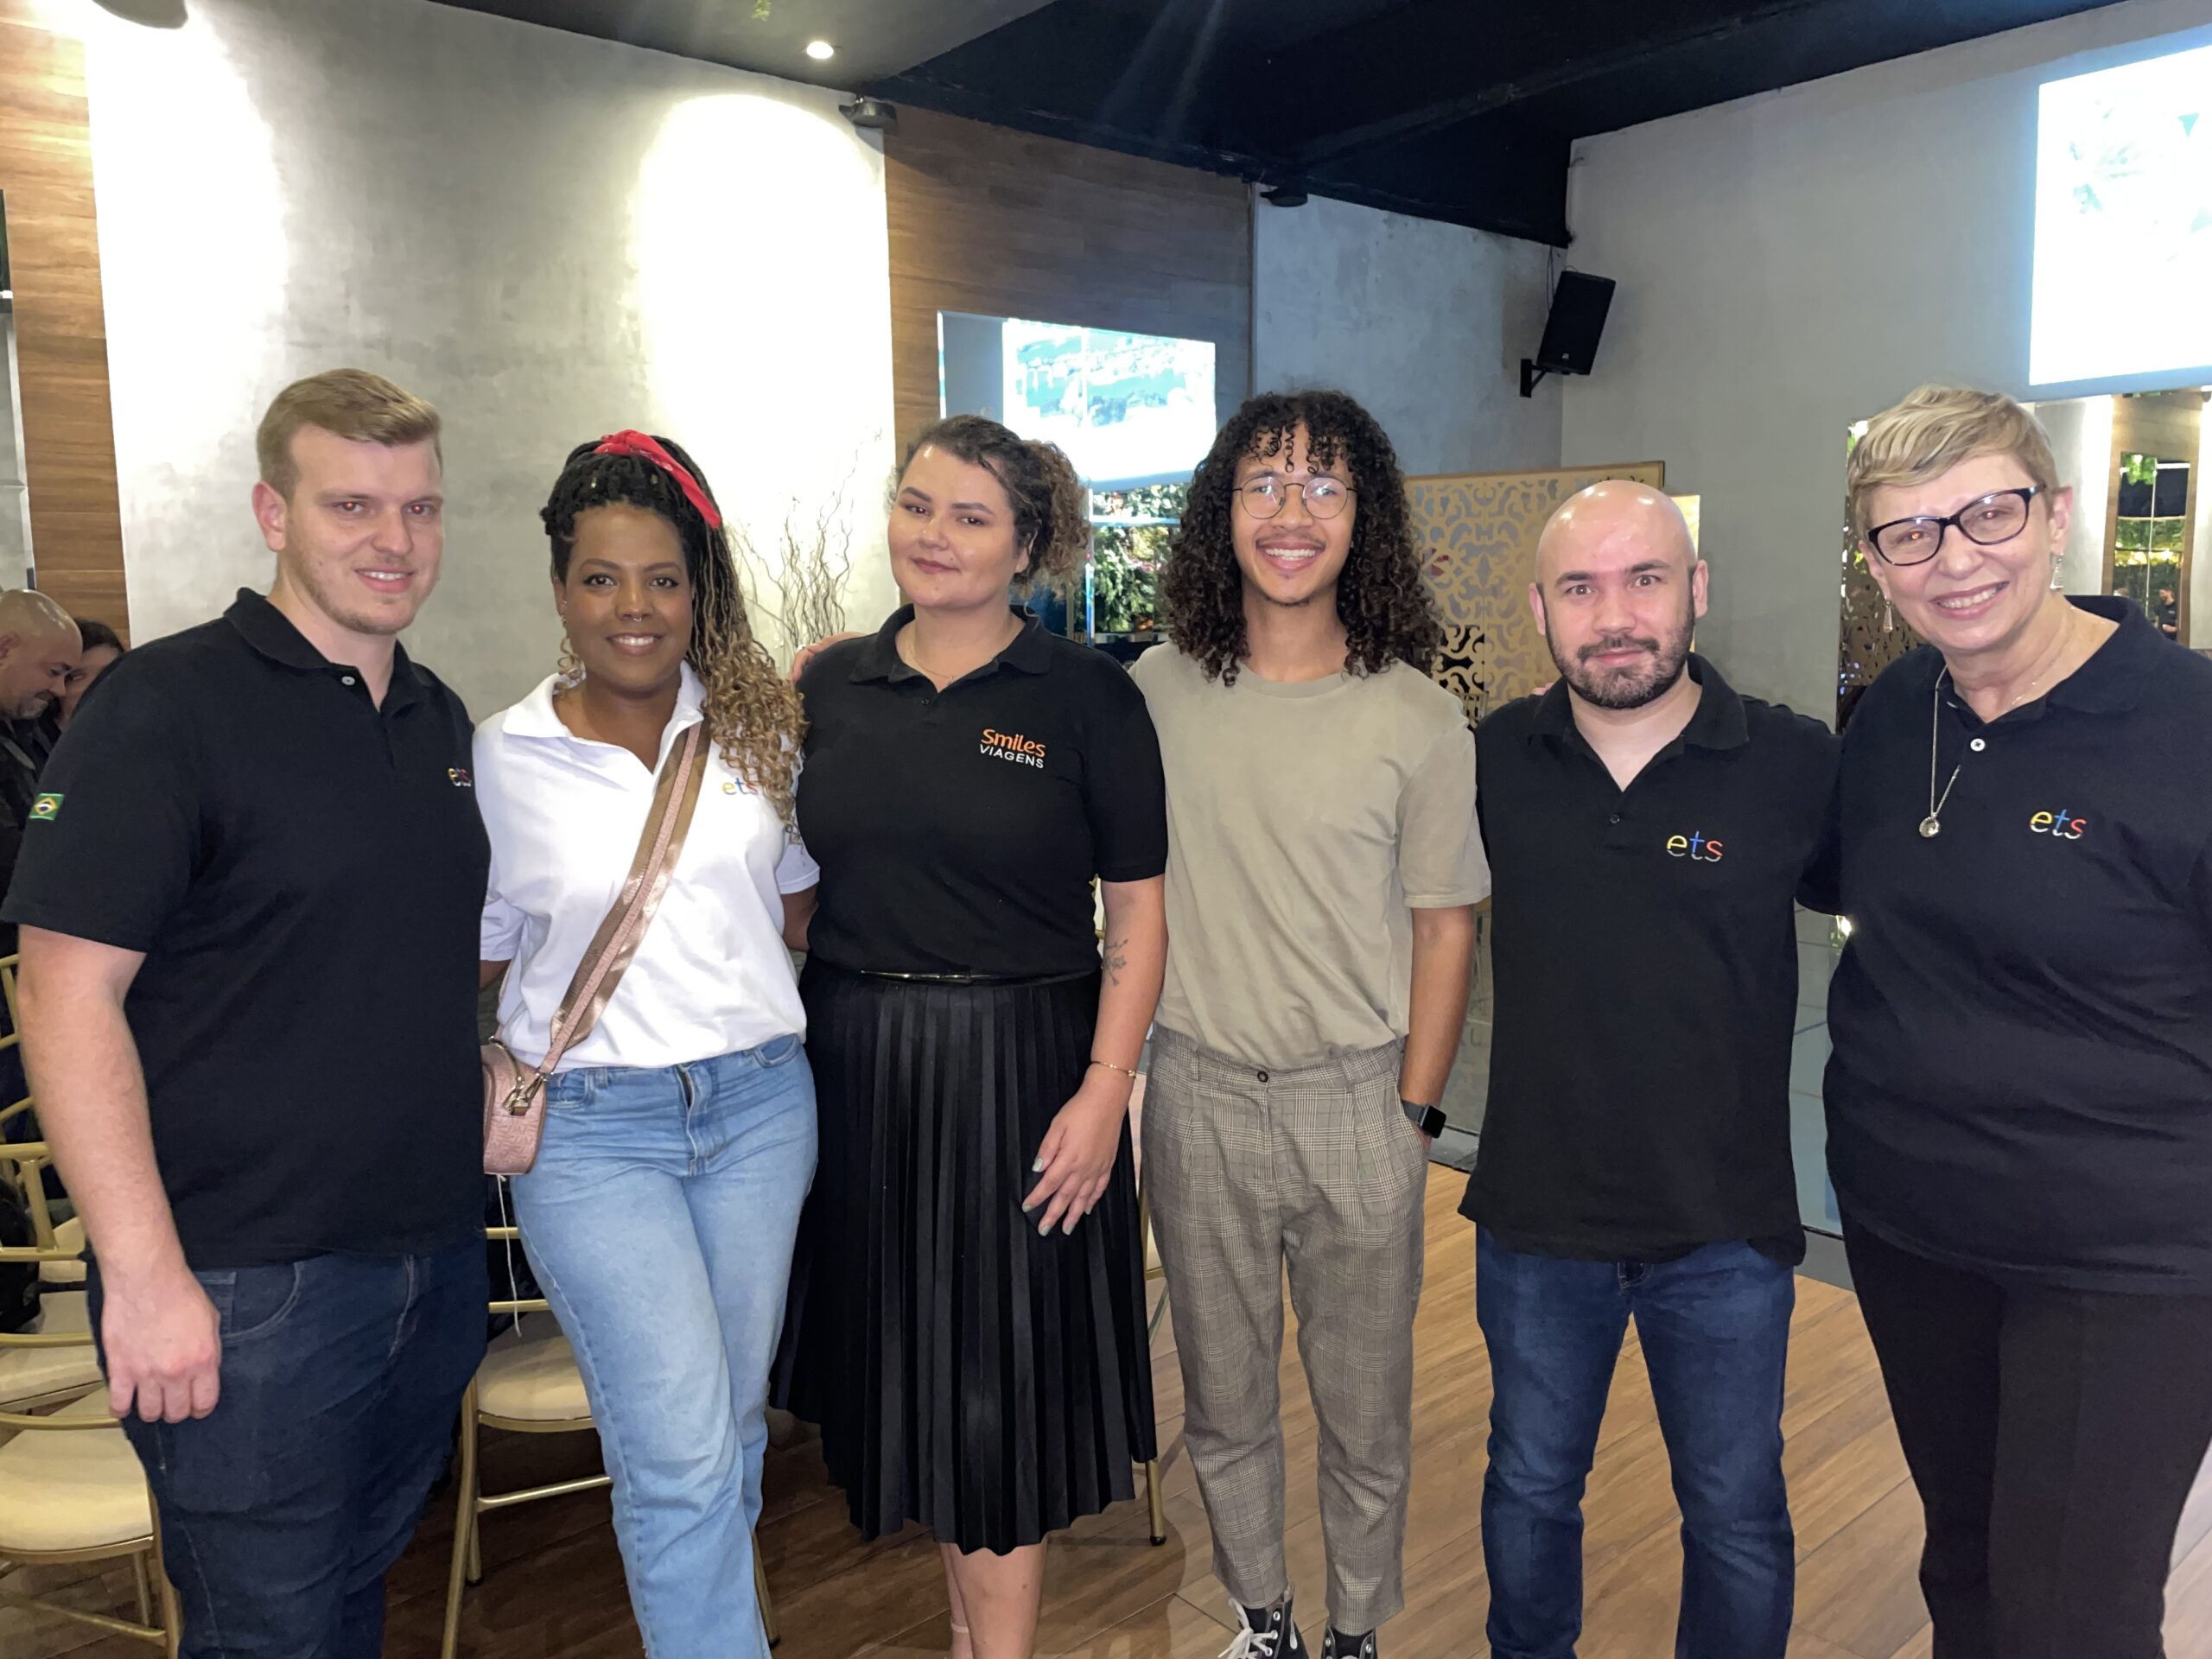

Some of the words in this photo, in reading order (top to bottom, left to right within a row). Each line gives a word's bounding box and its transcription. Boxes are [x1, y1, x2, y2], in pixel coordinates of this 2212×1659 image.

[980, 744, 1044, 769] VIAGENS
[981, 728, 1046, 758] Smiles
[722, 777, 759, 795] ets
[2031, 809, 2087, 840] ets
[1667, 830, 1723, 862] ets
